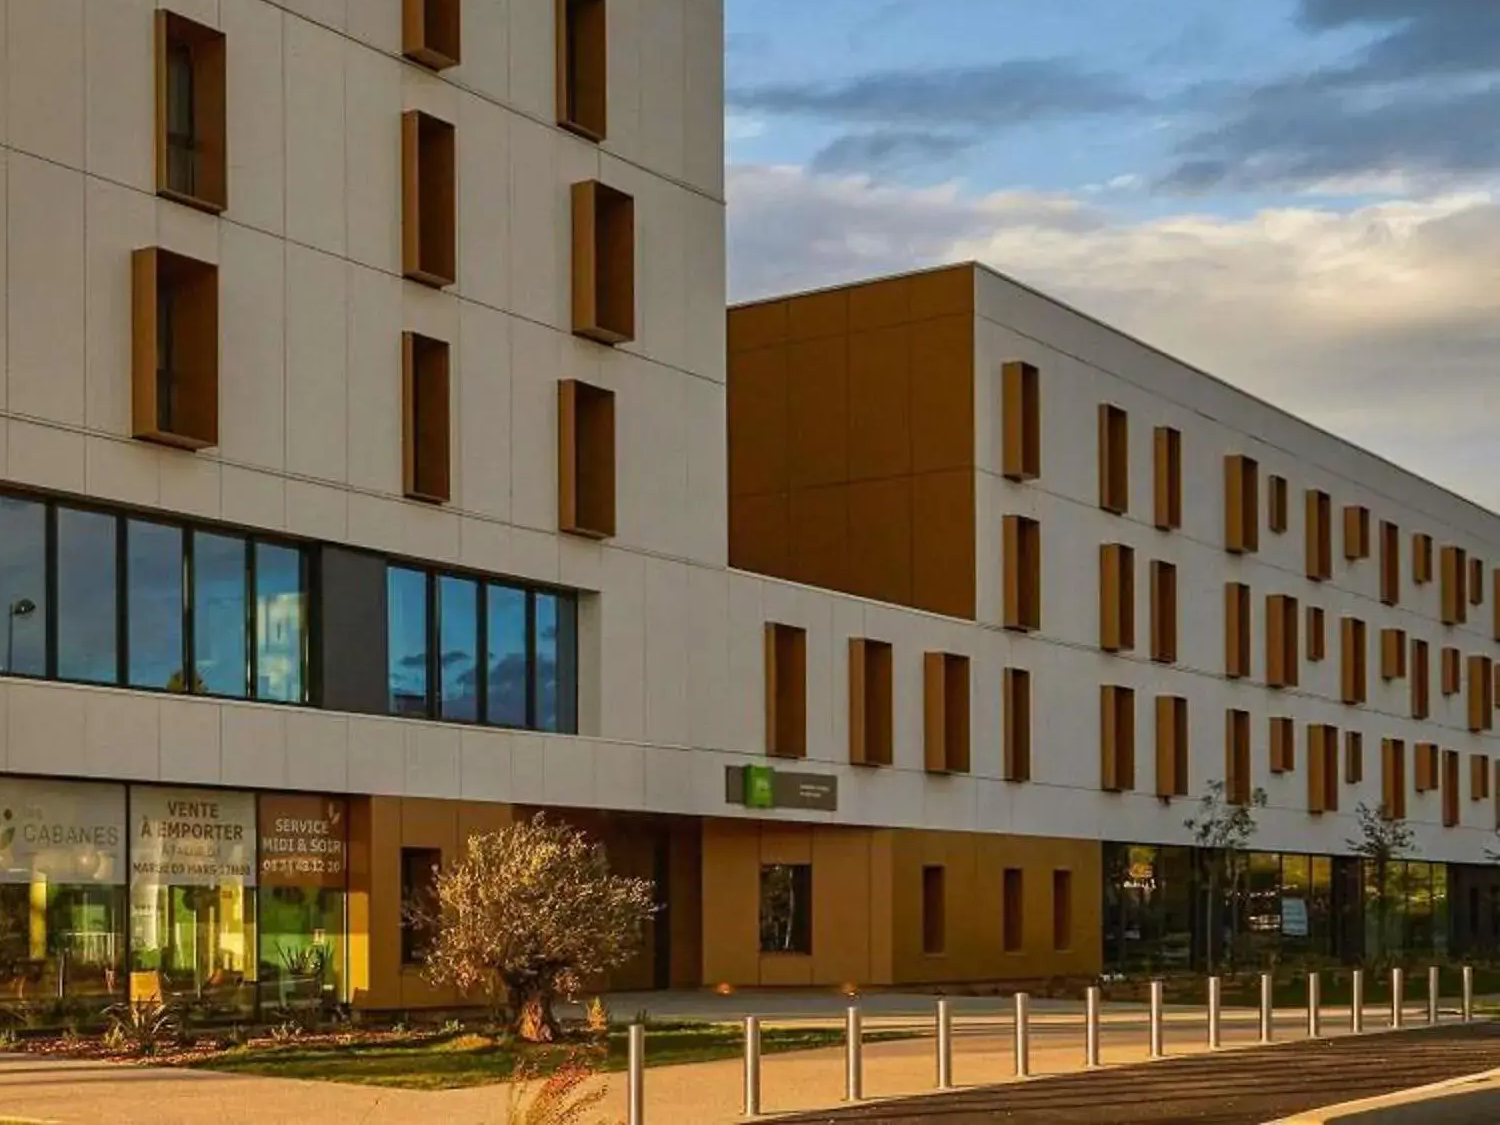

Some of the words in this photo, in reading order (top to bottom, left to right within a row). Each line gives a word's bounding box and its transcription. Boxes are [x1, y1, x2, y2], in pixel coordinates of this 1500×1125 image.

[167, 800, 220, 818] VENTE
[23, 822, 120, 847] CABANES
[141, 815, 153, 838] À
[159, 820, 244, 841] EMPORTER
[275, 817, 330, 834] SERVICE
[263, 837, 294, 853] MIDI
[309, 836, 342, 853] SOIR
